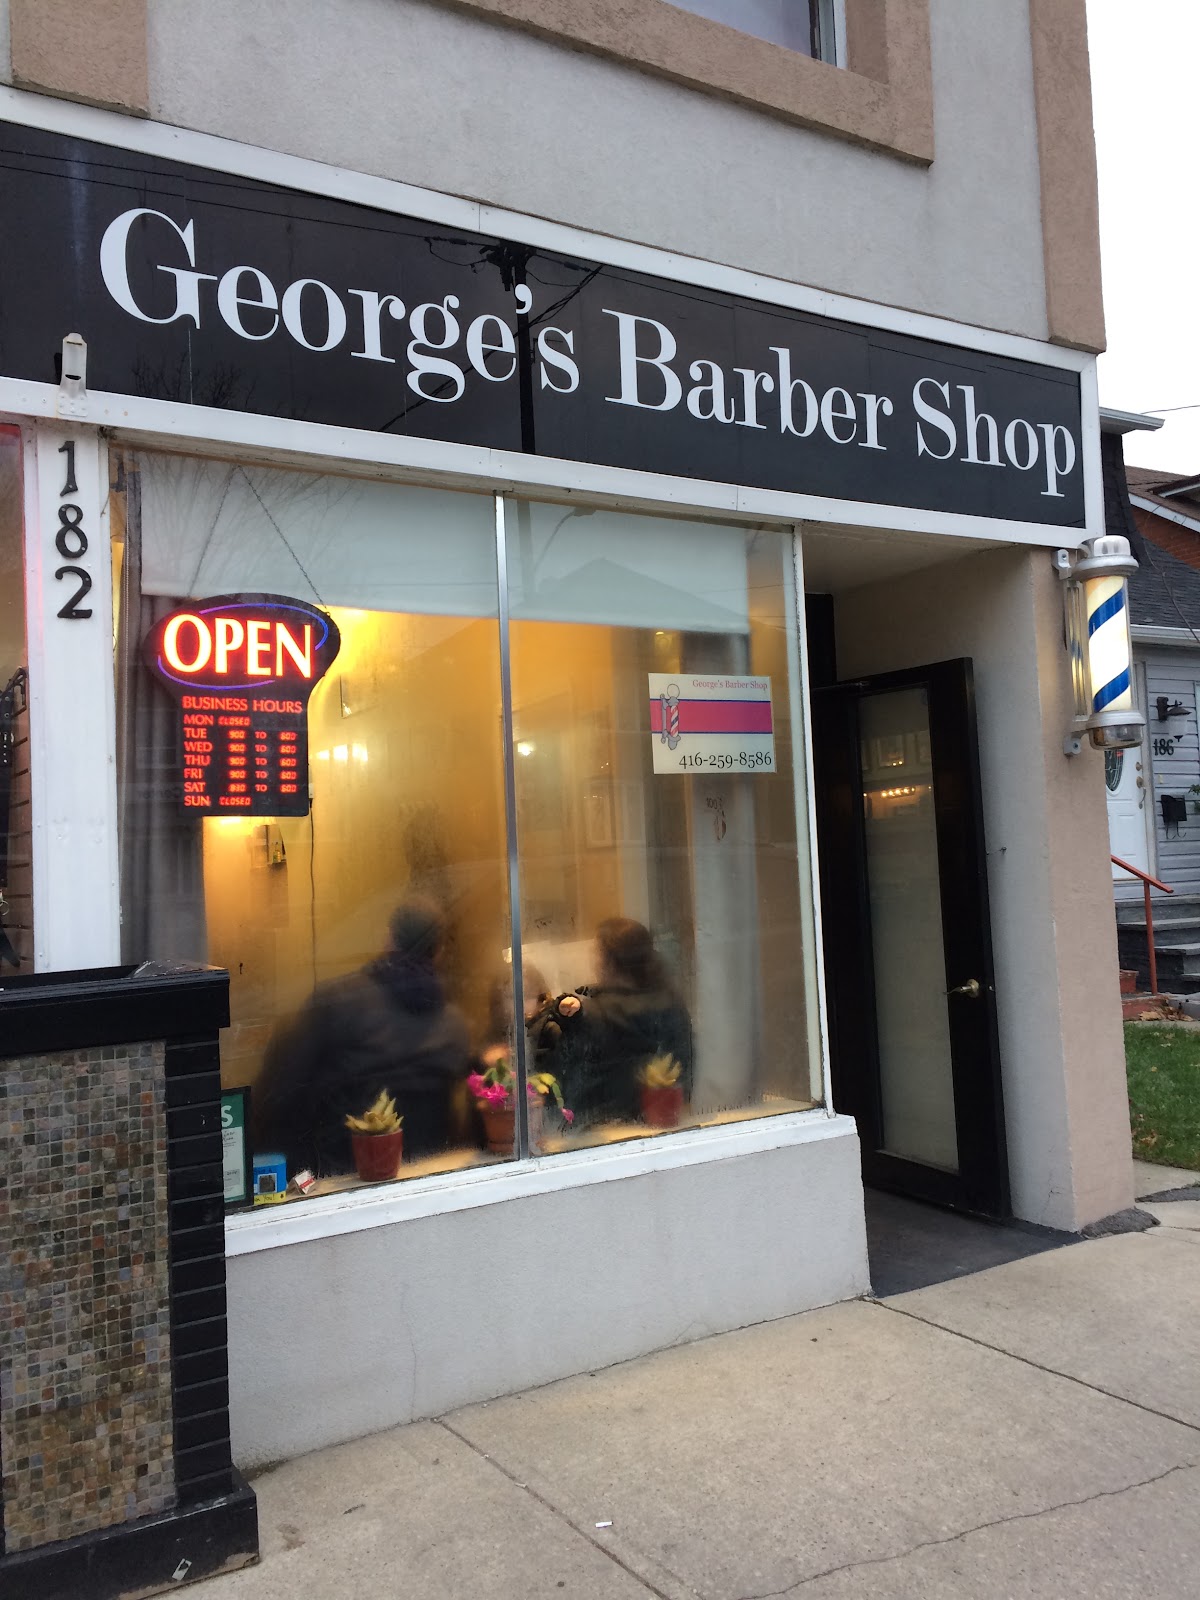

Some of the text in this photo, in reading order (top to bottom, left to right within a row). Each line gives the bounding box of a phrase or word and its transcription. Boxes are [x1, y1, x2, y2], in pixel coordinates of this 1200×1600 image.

[100, 208, 1076, 497] George's Barber Shop
[55, 440, 92, 619] 182
[163, 613, 312, 679] OPEN
[692, 679, 768, 692] George's Barber Shop
[182, 696, 302, 713] BUSINESS HOURS
[183, 714, 250, 727] MON CLOSED
[183, 728, 207, 739] TUE
[254, 731, 267, 739] TO
[184, 742, 213, 753] WED
[254, 744, 268, 753] TO
[1153, 739, 1174, 756] 186
[184, 755, 211, 766] THU
[255, 757, 268, 766] TO
[679, 752, 772, 769] 416-259-8586
[184, 768, 203, 779] FRI
[255, 770, 268, 779] TO
[184, 782, 206, 793] SAT
[255, 784, 268, 792] TO
[184, 795, 252, 807] SUN CLOSED
